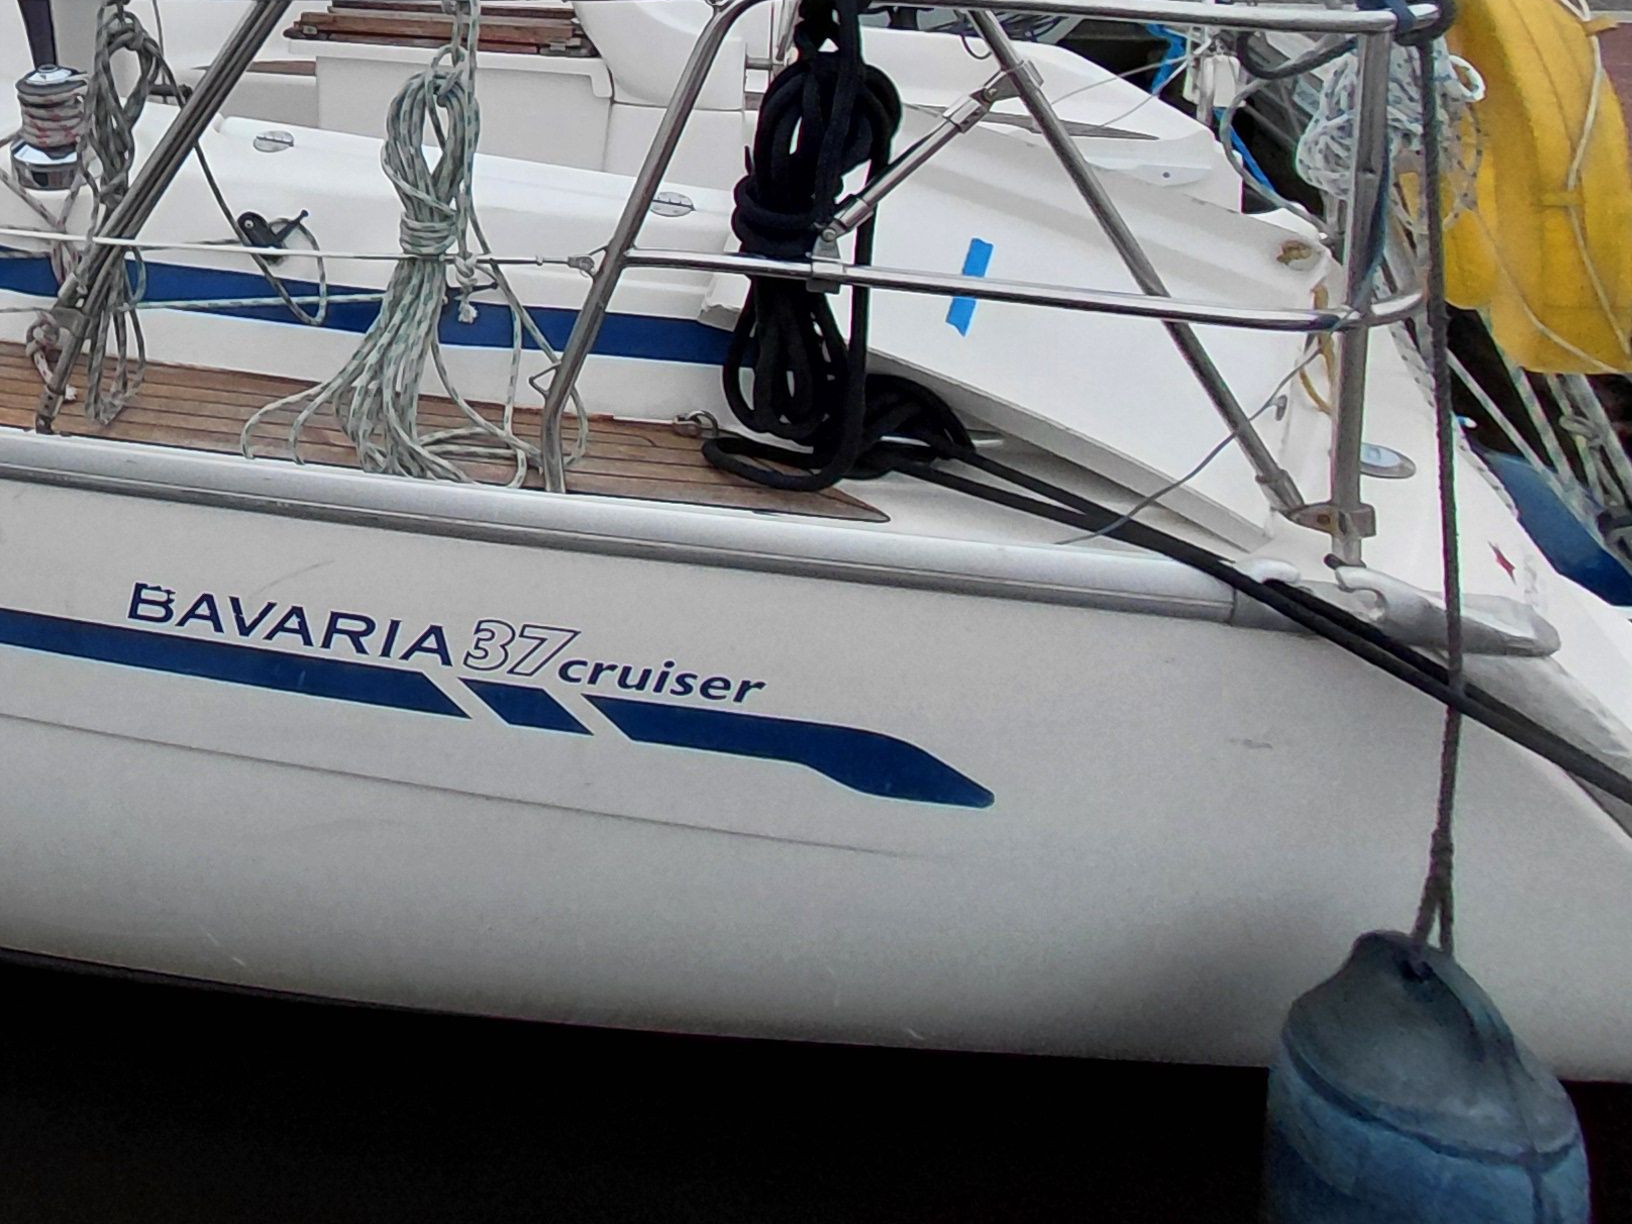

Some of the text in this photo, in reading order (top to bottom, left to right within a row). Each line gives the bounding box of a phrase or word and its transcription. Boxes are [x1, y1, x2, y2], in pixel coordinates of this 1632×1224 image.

[128, 582, 766, 703] BAVARIA 37 cruiser
